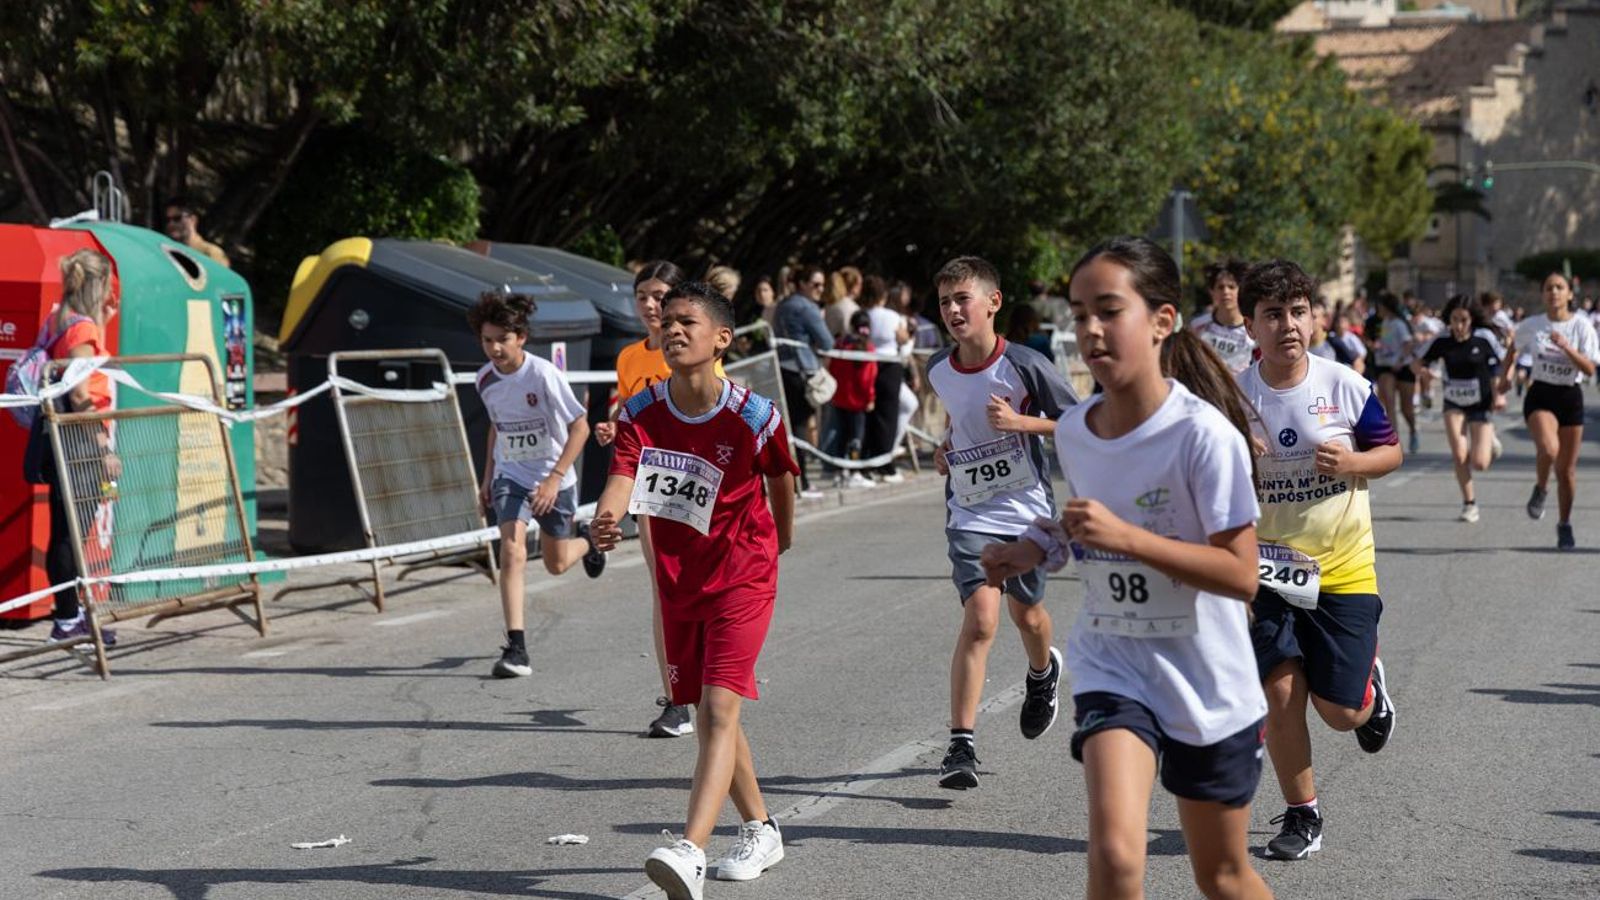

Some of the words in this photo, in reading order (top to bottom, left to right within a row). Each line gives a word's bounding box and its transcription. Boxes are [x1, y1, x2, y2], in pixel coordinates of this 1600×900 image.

[507, 433, 538, 448] 770
[965, 459, 1011, 485] 798
[645, 472, 708, 508] 1348
[1267, 481, 1347, 503] APÓSTOLES
[1108, 572, 1149, 604] 98
